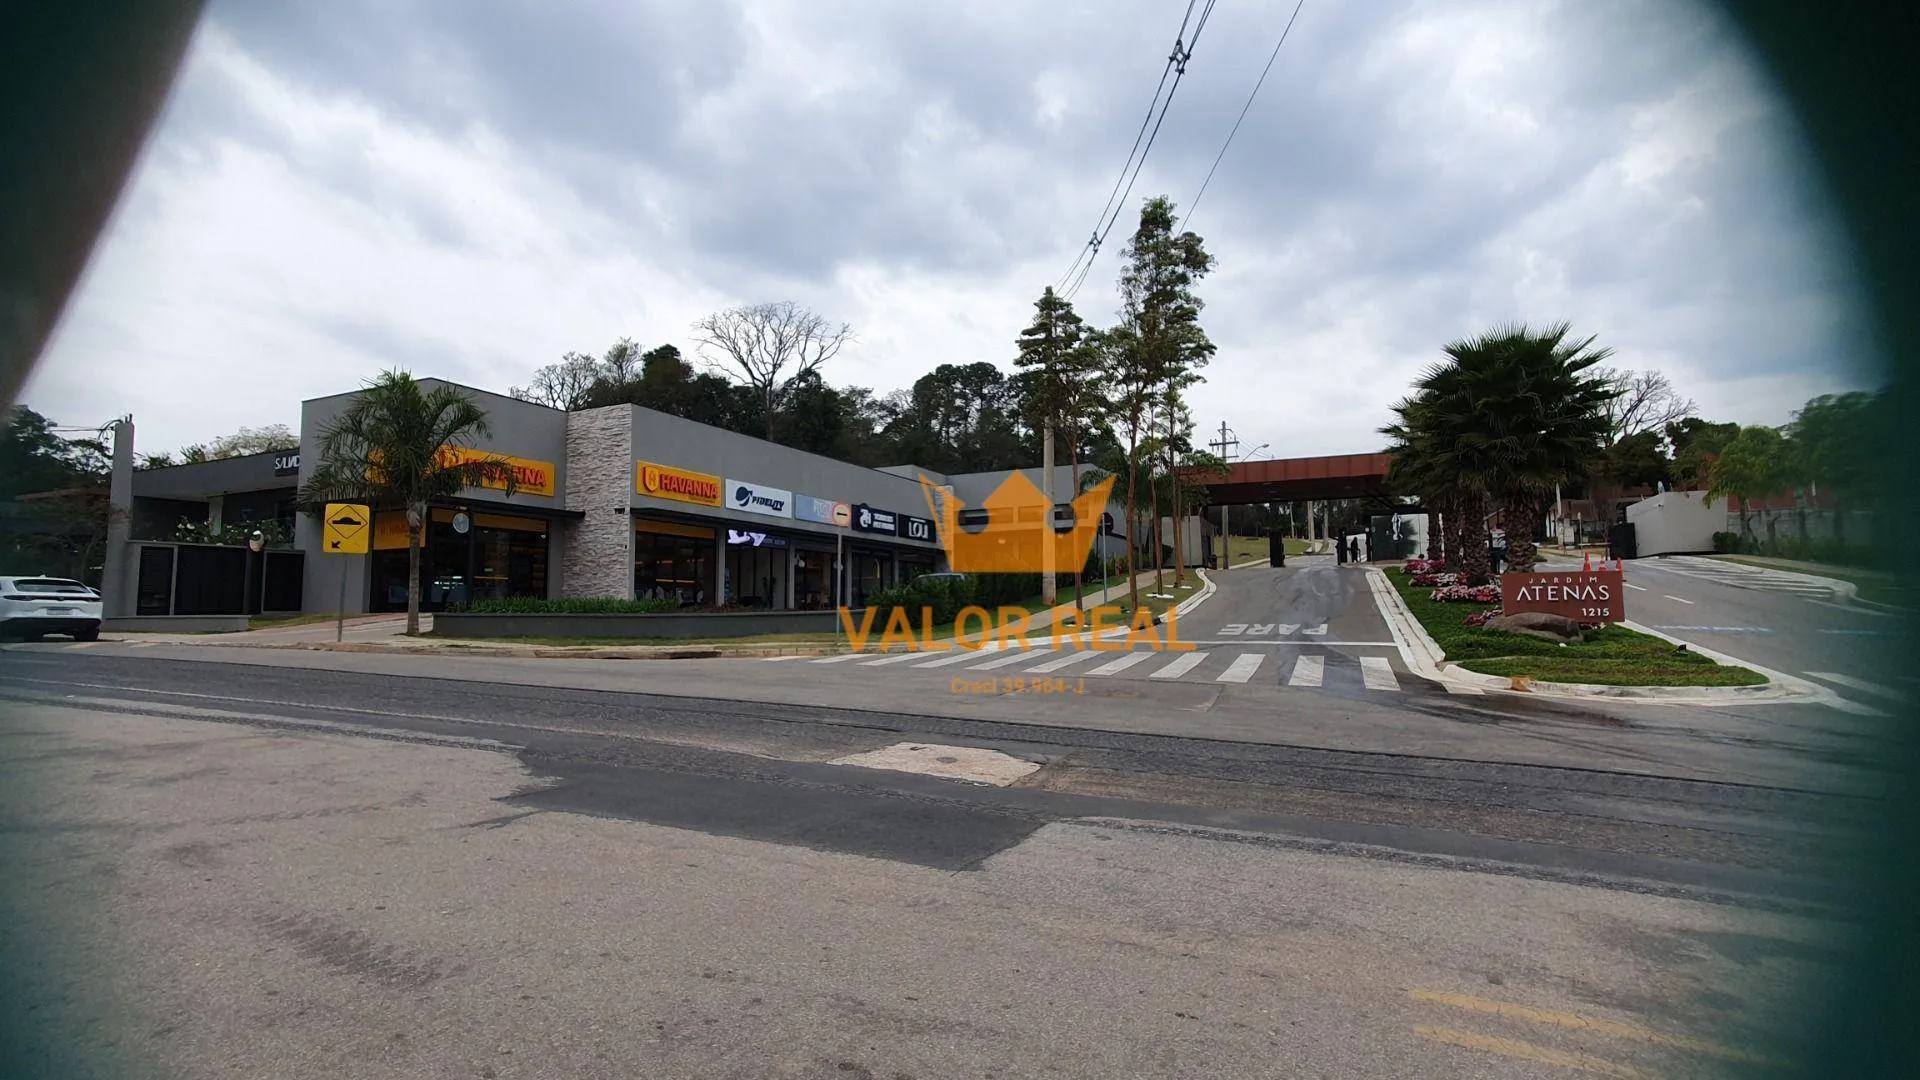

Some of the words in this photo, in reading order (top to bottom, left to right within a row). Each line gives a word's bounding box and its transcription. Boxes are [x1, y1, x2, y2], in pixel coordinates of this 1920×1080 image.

[660, 474, 717, 499] HAVANNA
[752, 496, 784, 509] FIDELITY
[1528, 576, 1598, 584] JARDIM
[1516, 585, 1610, 601] ATENAS
[1581, 608, 1610, 617] 1215
[1217, 623, 1328, 636] PARE
